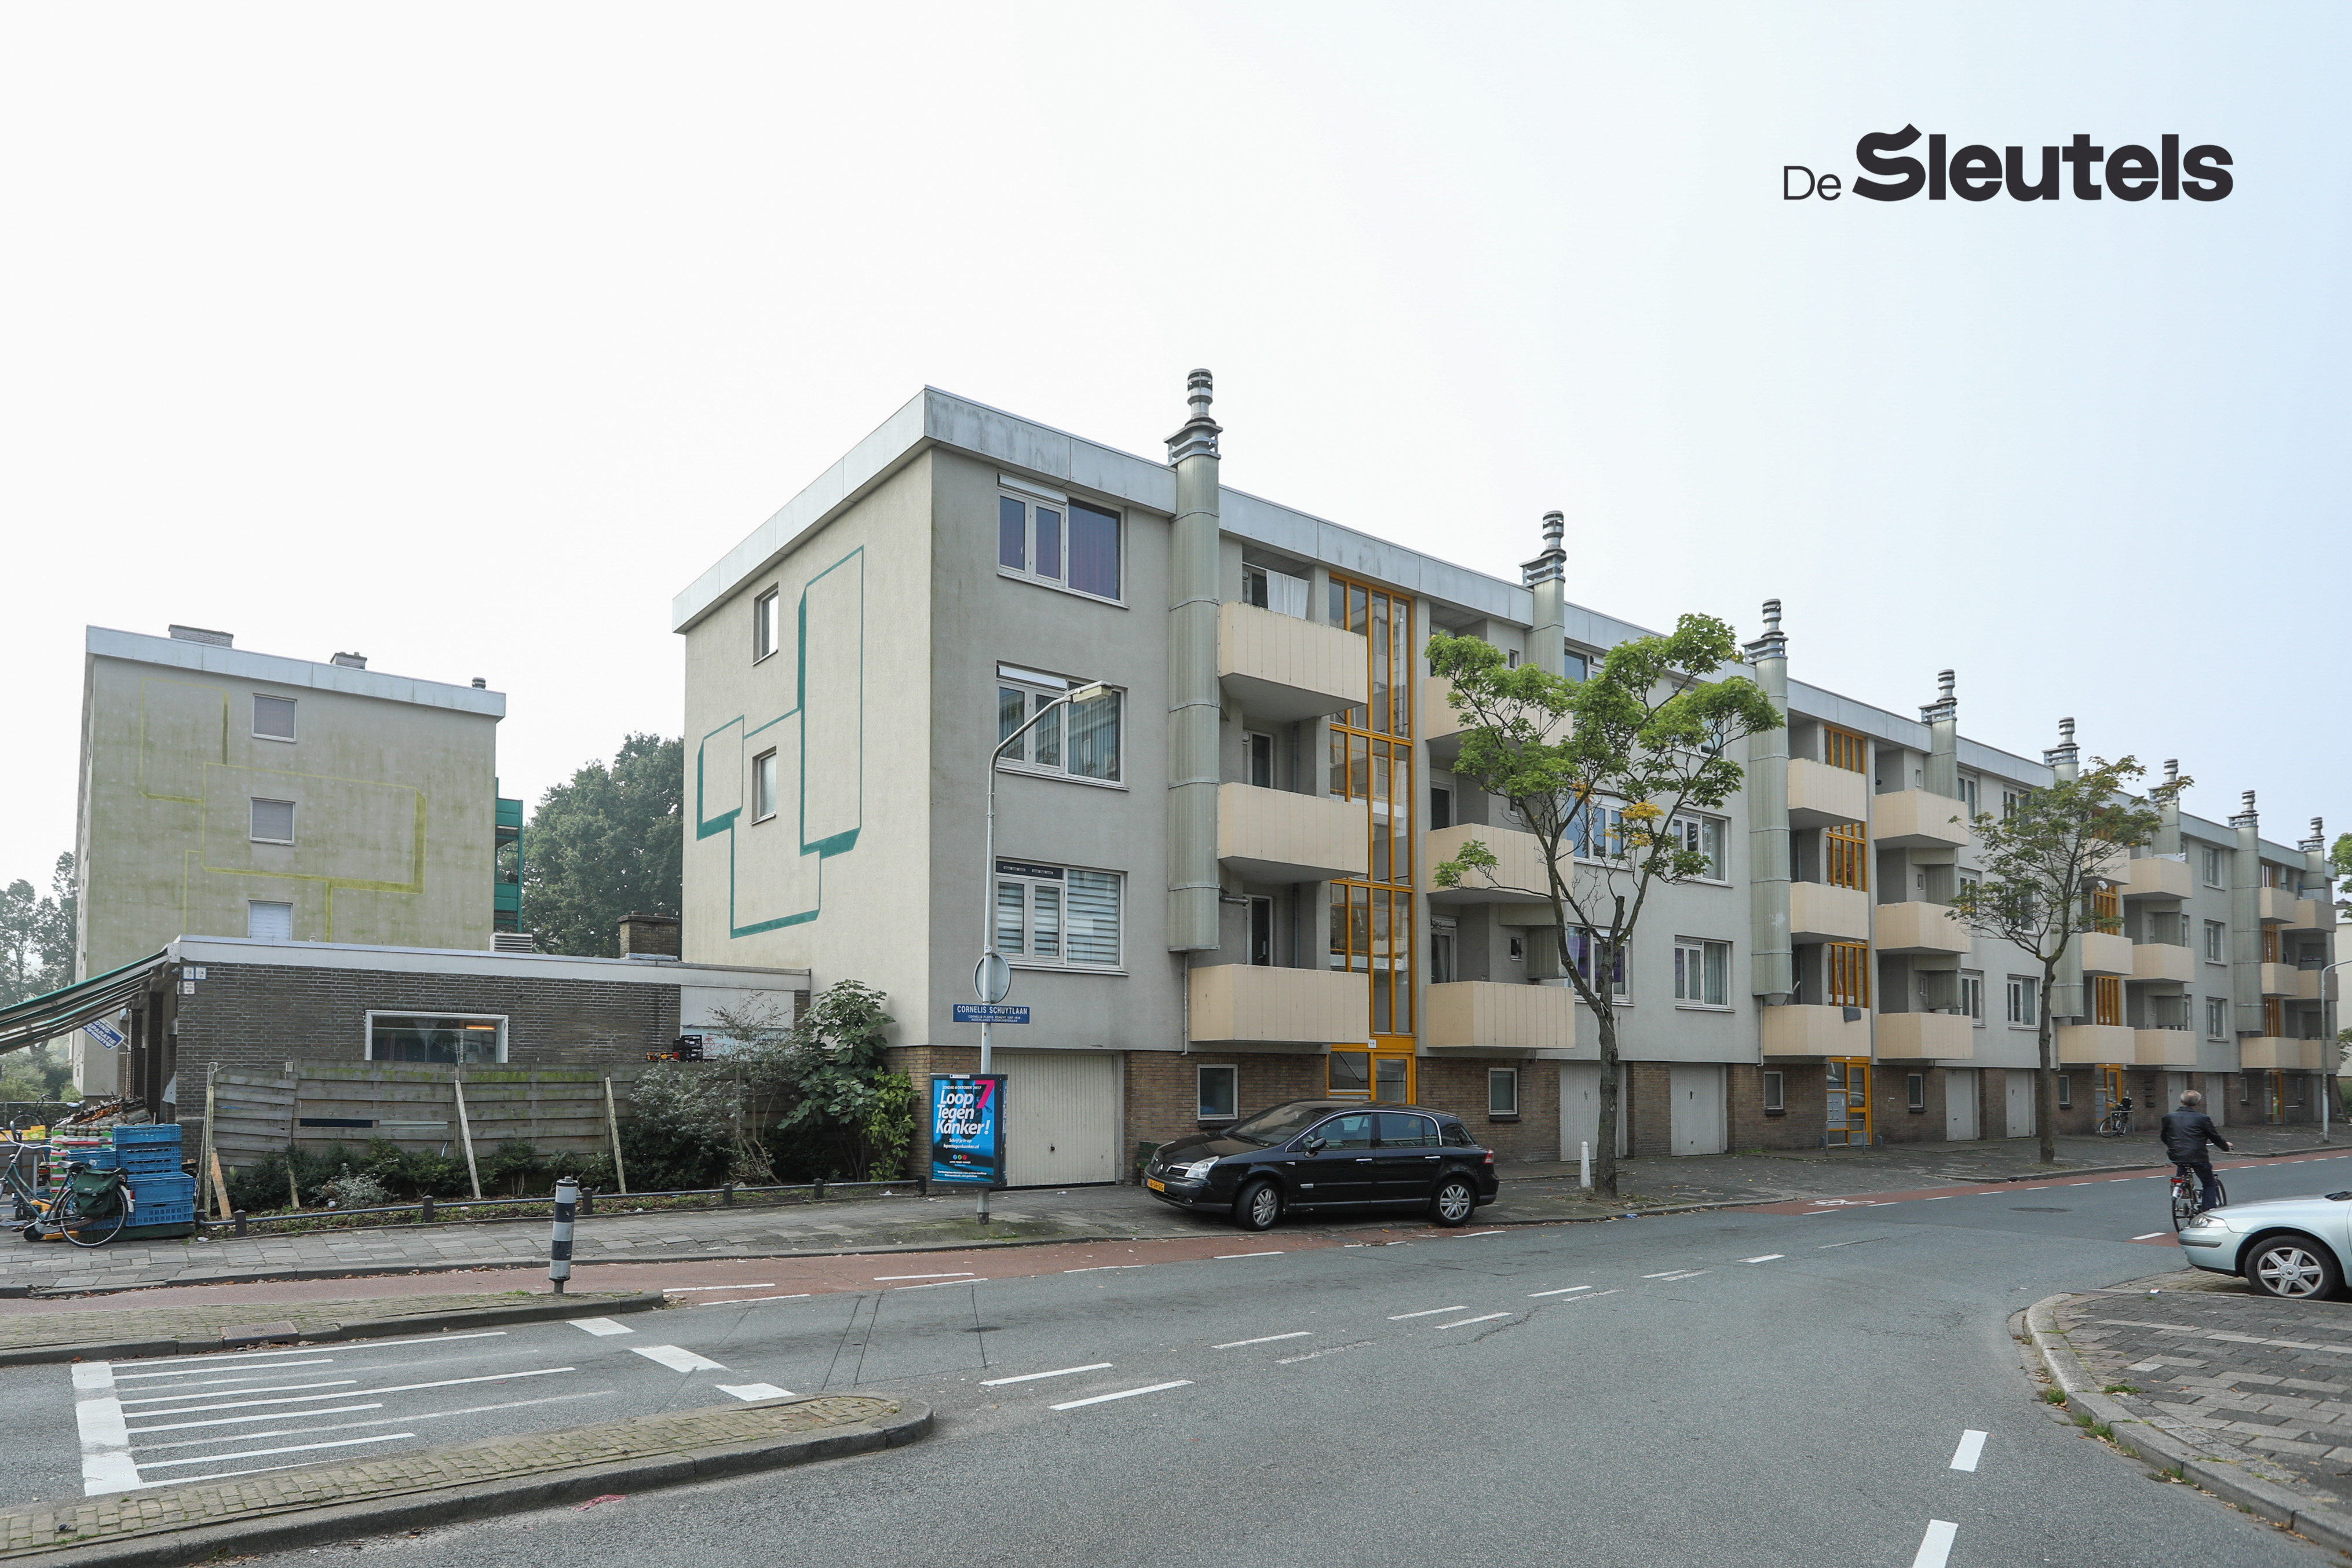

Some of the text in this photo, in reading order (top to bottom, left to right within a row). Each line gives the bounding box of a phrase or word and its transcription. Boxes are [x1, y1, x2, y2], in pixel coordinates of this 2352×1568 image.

[957, 1005, 987, 1014] CORNELIS
[93, 1021, 112, 1035] DING-
[940, 1090, 974, 1109] Loop
[937, 1104, 974, 1123] Tegen
[936, 1119, 991, 1135] Kanker!
